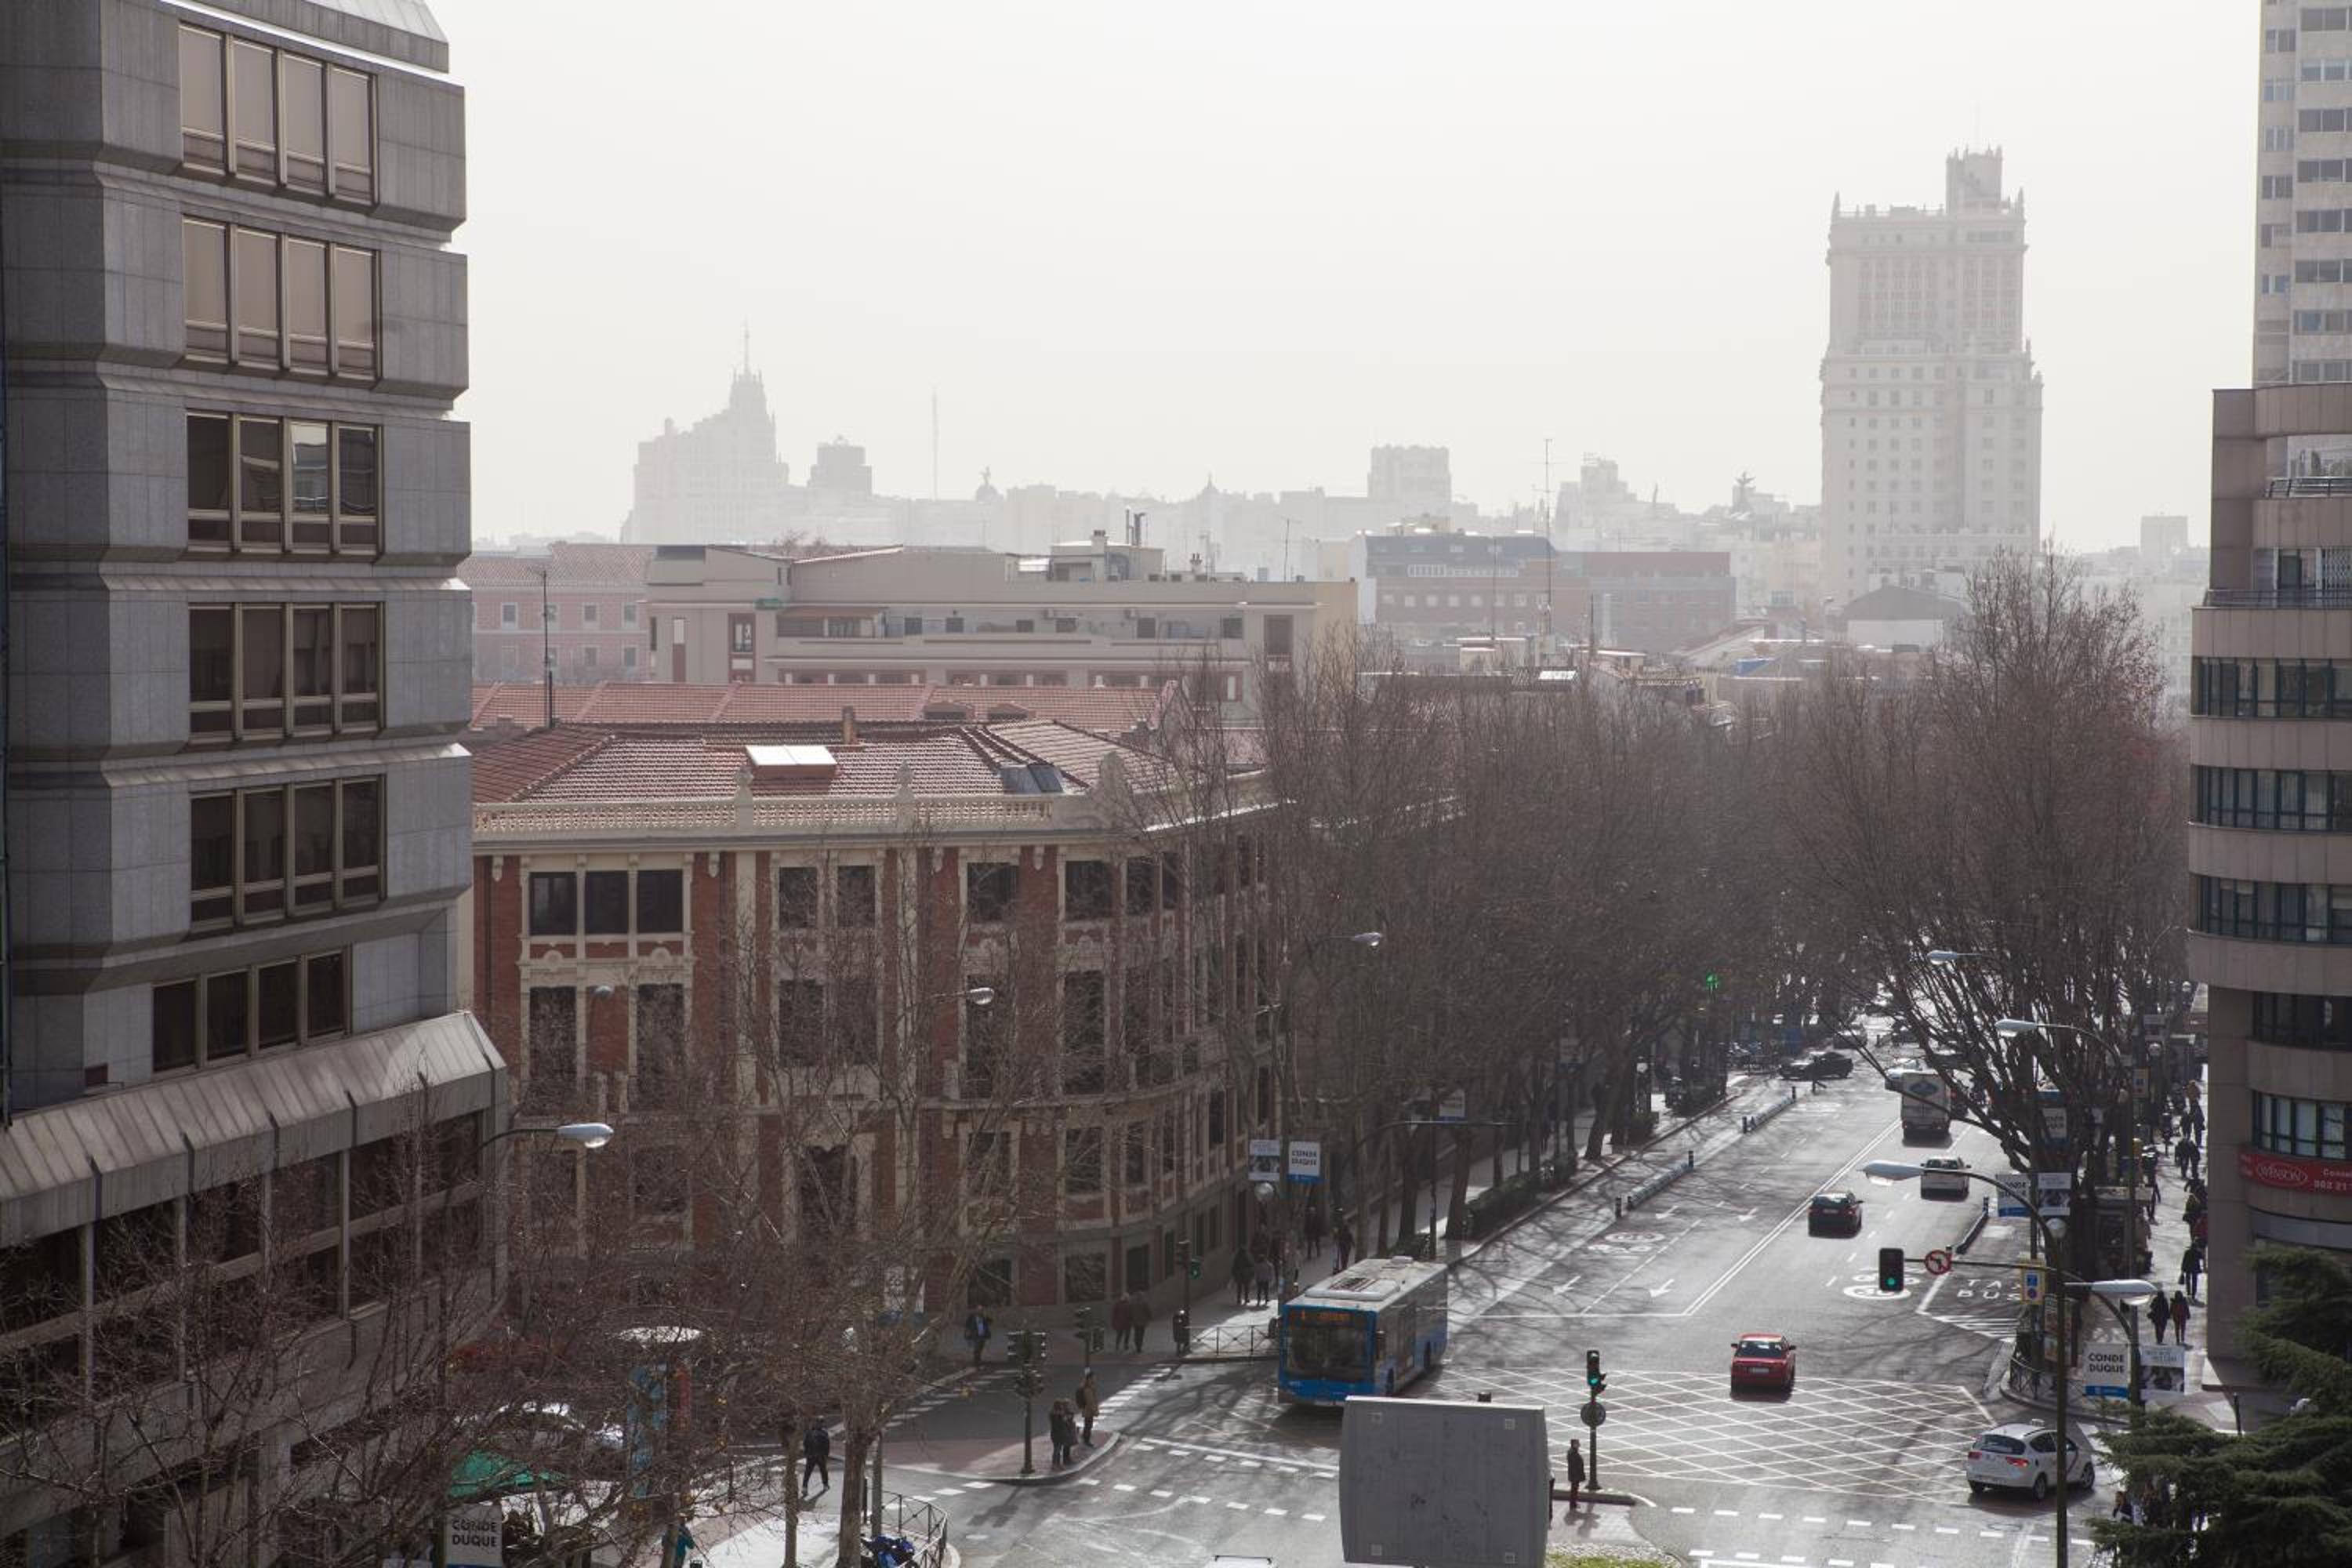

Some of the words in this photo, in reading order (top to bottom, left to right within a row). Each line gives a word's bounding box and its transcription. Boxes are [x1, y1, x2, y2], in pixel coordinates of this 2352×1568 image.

[2088, 1352, 2124, 1363] CONDE
[2089, 1363, 2125, 1373] DUQUE
[452, 1519, 497, 1532] CONDE
[452, 1534, 497, 1547] DUQUE
